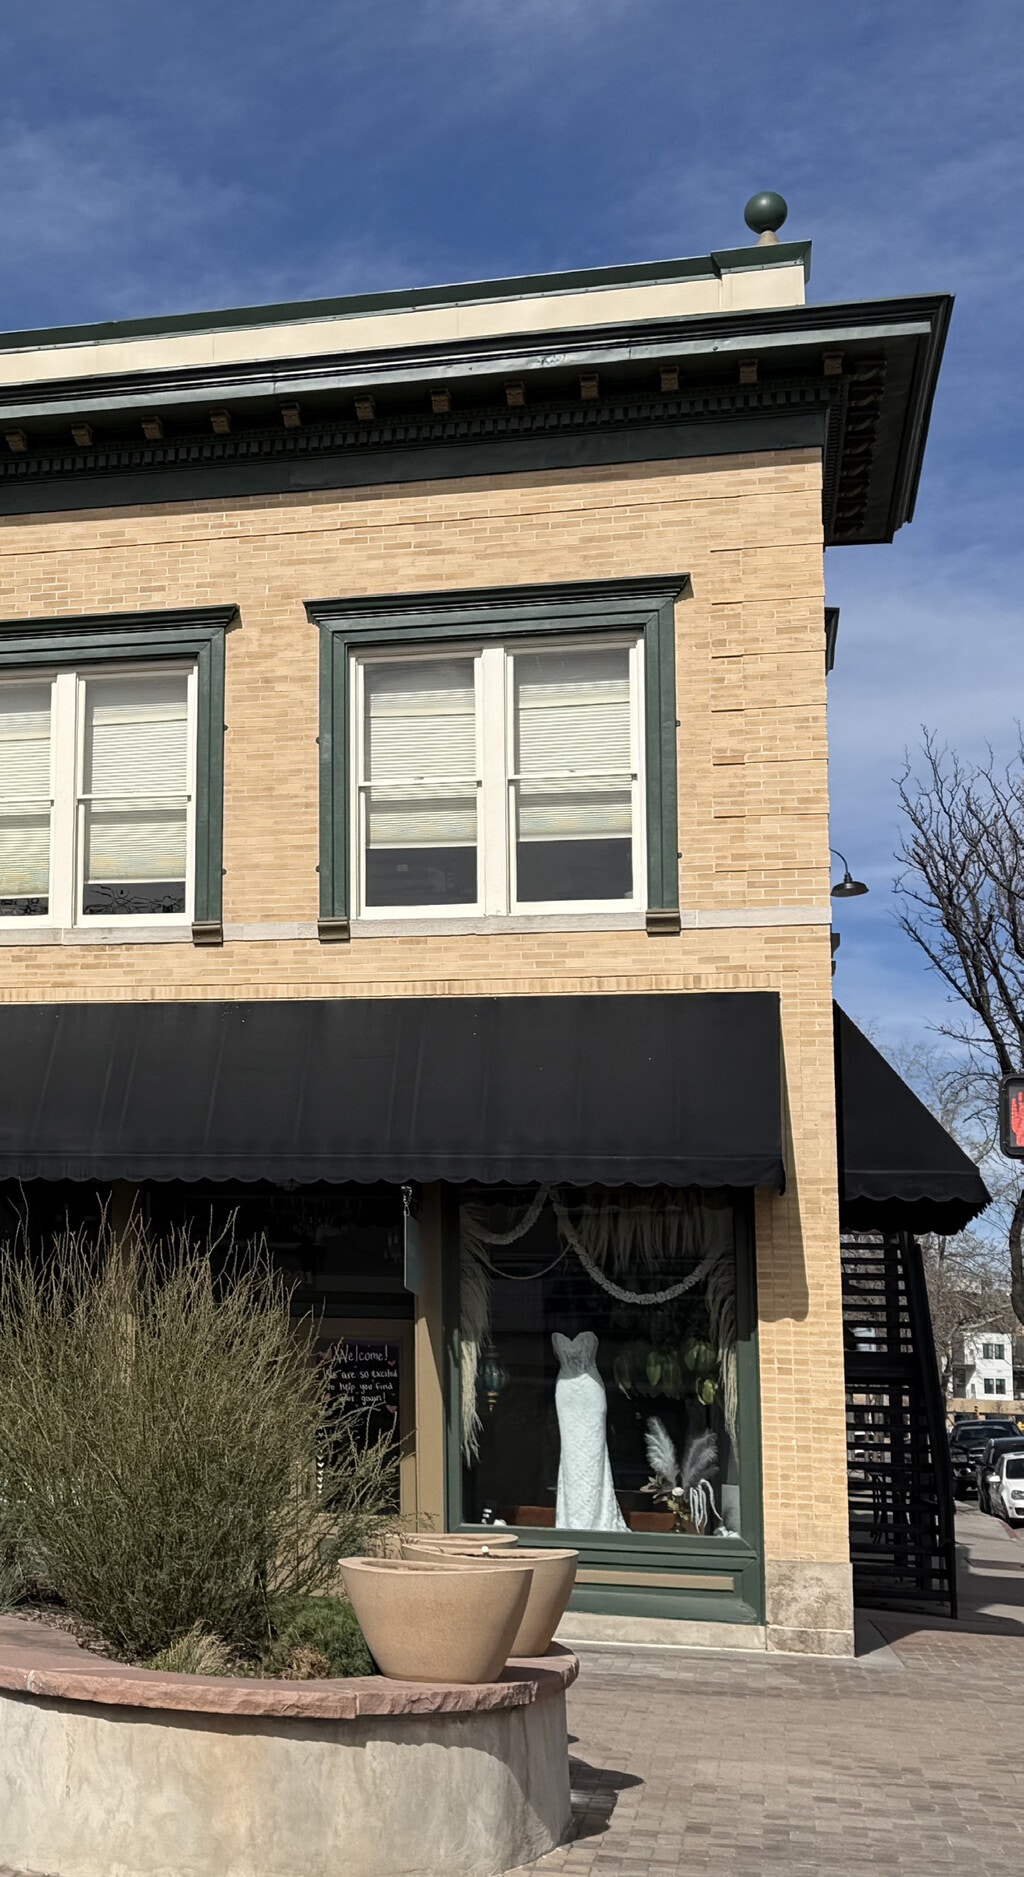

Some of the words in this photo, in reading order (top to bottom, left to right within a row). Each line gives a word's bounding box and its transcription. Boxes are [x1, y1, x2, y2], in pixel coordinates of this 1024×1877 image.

[334, 1344, 388, 1364] Welcome!
[341, 1371, 356, 1380] are
[359, 1371, 370, 1379] so
[327, 1382, 336, 1391] to
[339, 1382, 356, 1394] help
[359, 1383, 373, 1395] you
